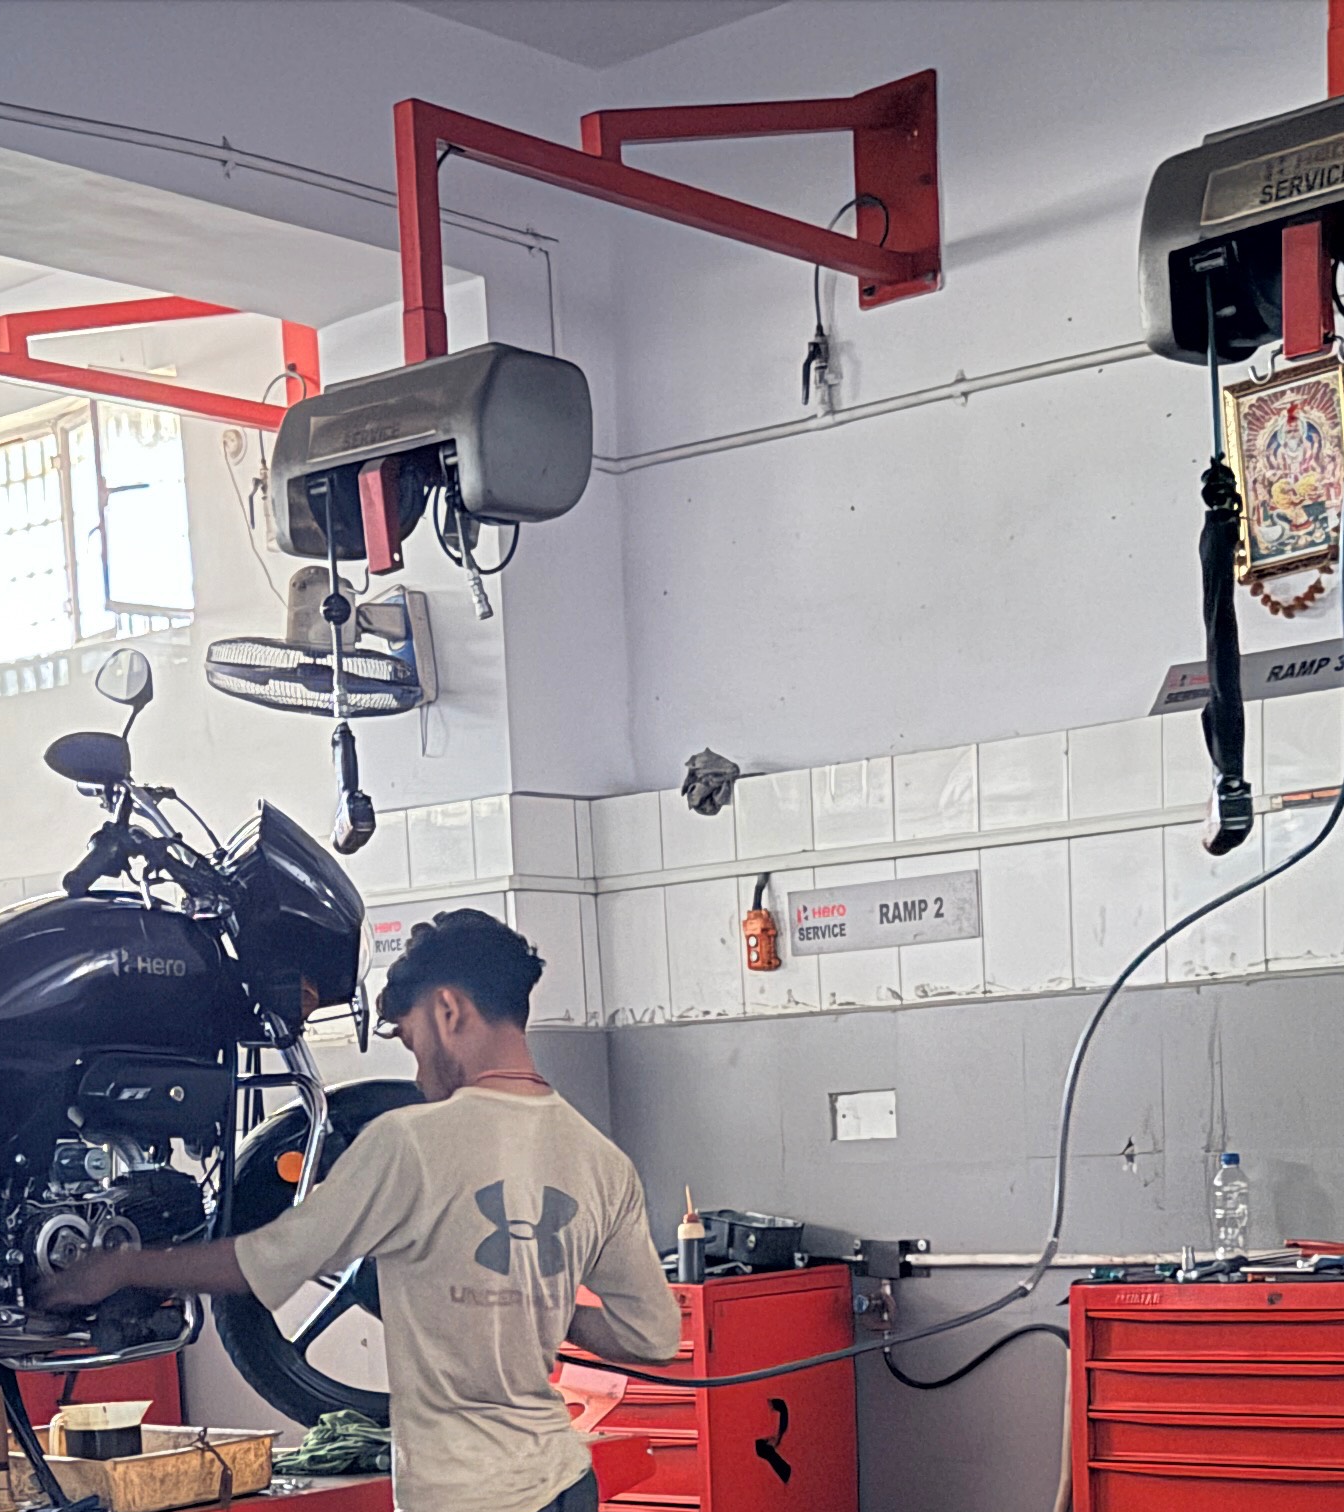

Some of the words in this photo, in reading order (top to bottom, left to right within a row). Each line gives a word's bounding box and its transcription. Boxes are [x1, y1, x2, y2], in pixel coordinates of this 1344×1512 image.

[1266, 656, 1332, 683] RAMP
[811, 903, 847, 919] Hero
[879, 898, 929, 925] RAMP
[934, 897, 944, 919] 2
[798, 923, 847, 941] SERVICE
[375, 937, 403, 953] RVICE
[137, 955, 187, 977] Hero
[755, 1398, 791, 1485] 2
